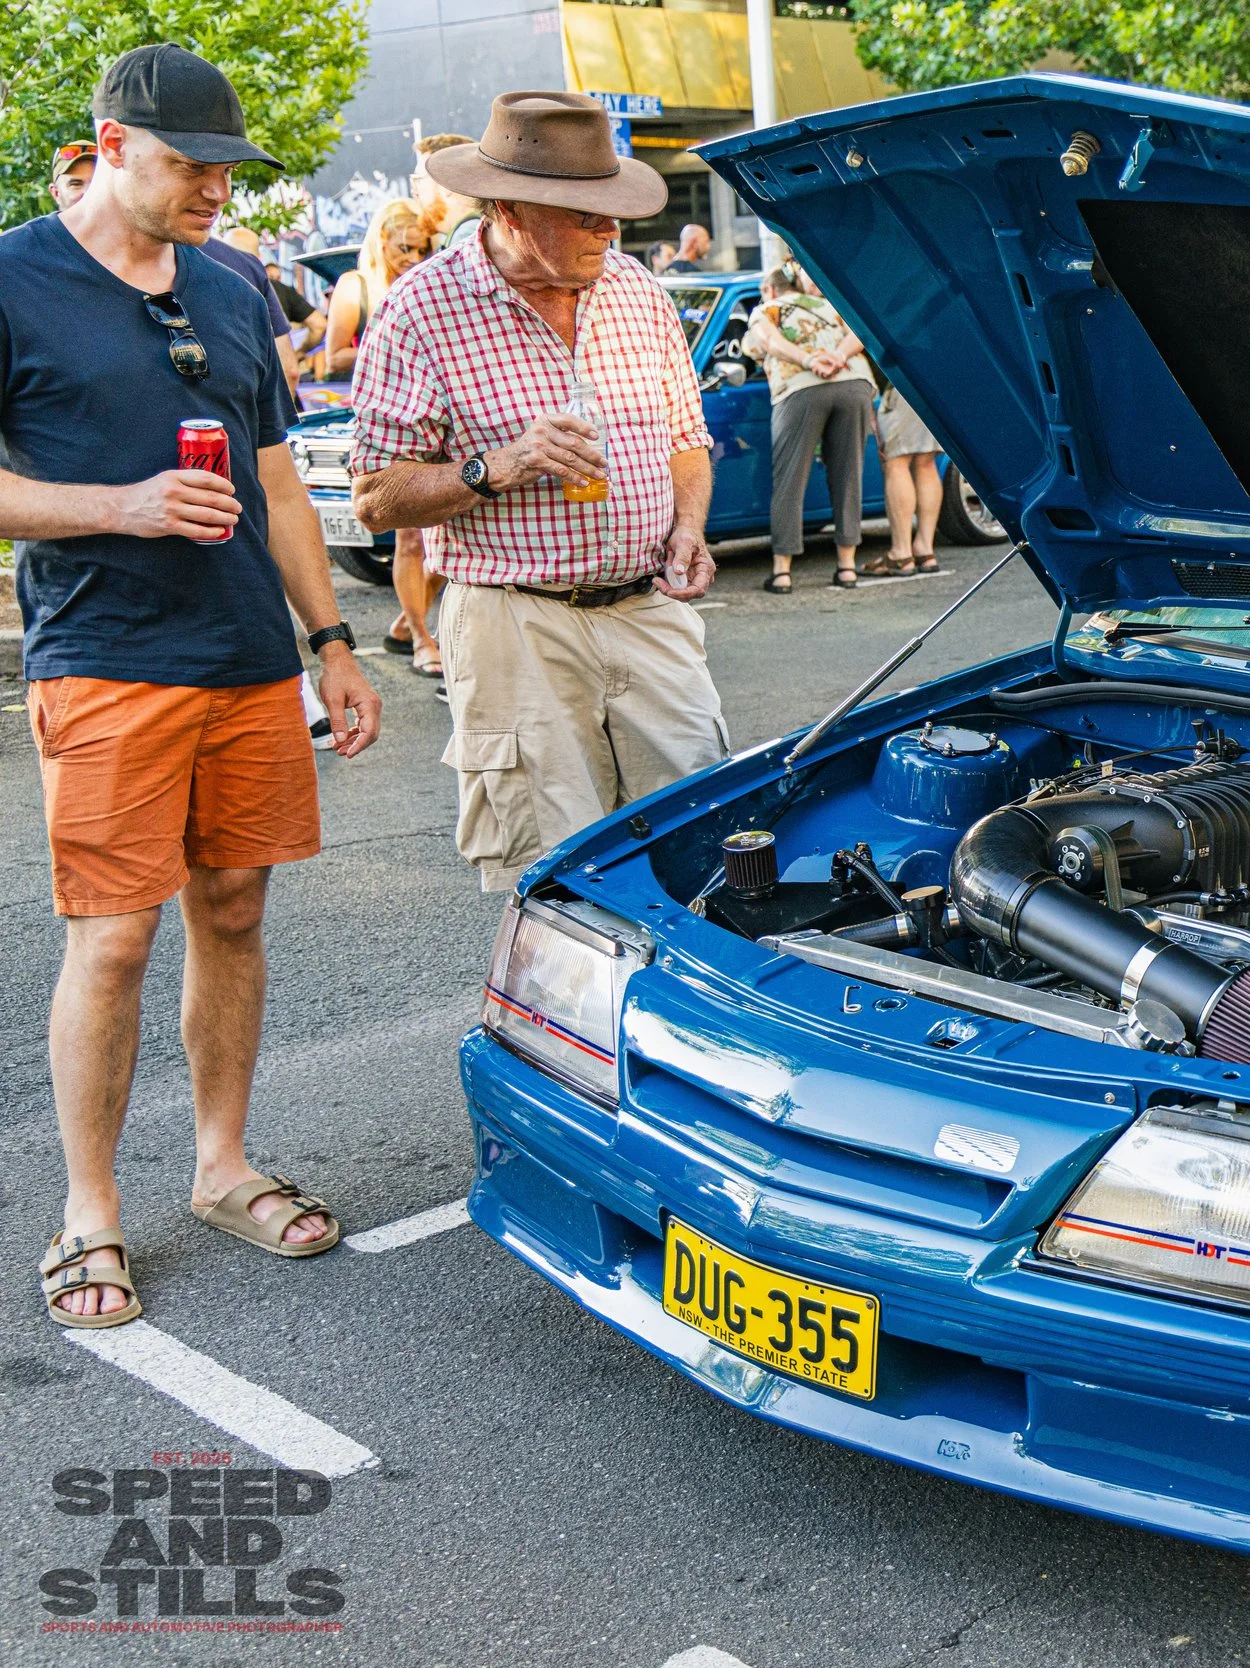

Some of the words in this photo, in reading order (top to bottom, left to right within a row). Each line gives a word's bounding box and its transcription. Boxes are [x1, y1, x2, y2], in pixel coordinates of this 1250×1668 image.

[627, 95, 661, 114] HERE
[1170, 930, 1199, 943] HARROP
[1196, 1241, 1227, 1259] HDT
[673, 1238, 861, 1374] DUG-355
[679, 1305, 703, 1328] NSW
[713, 1324, 735, 1347] THE
[739, 1338, 798, 1372] PREMIER
[803, 1363, 848, 1389] STATE
